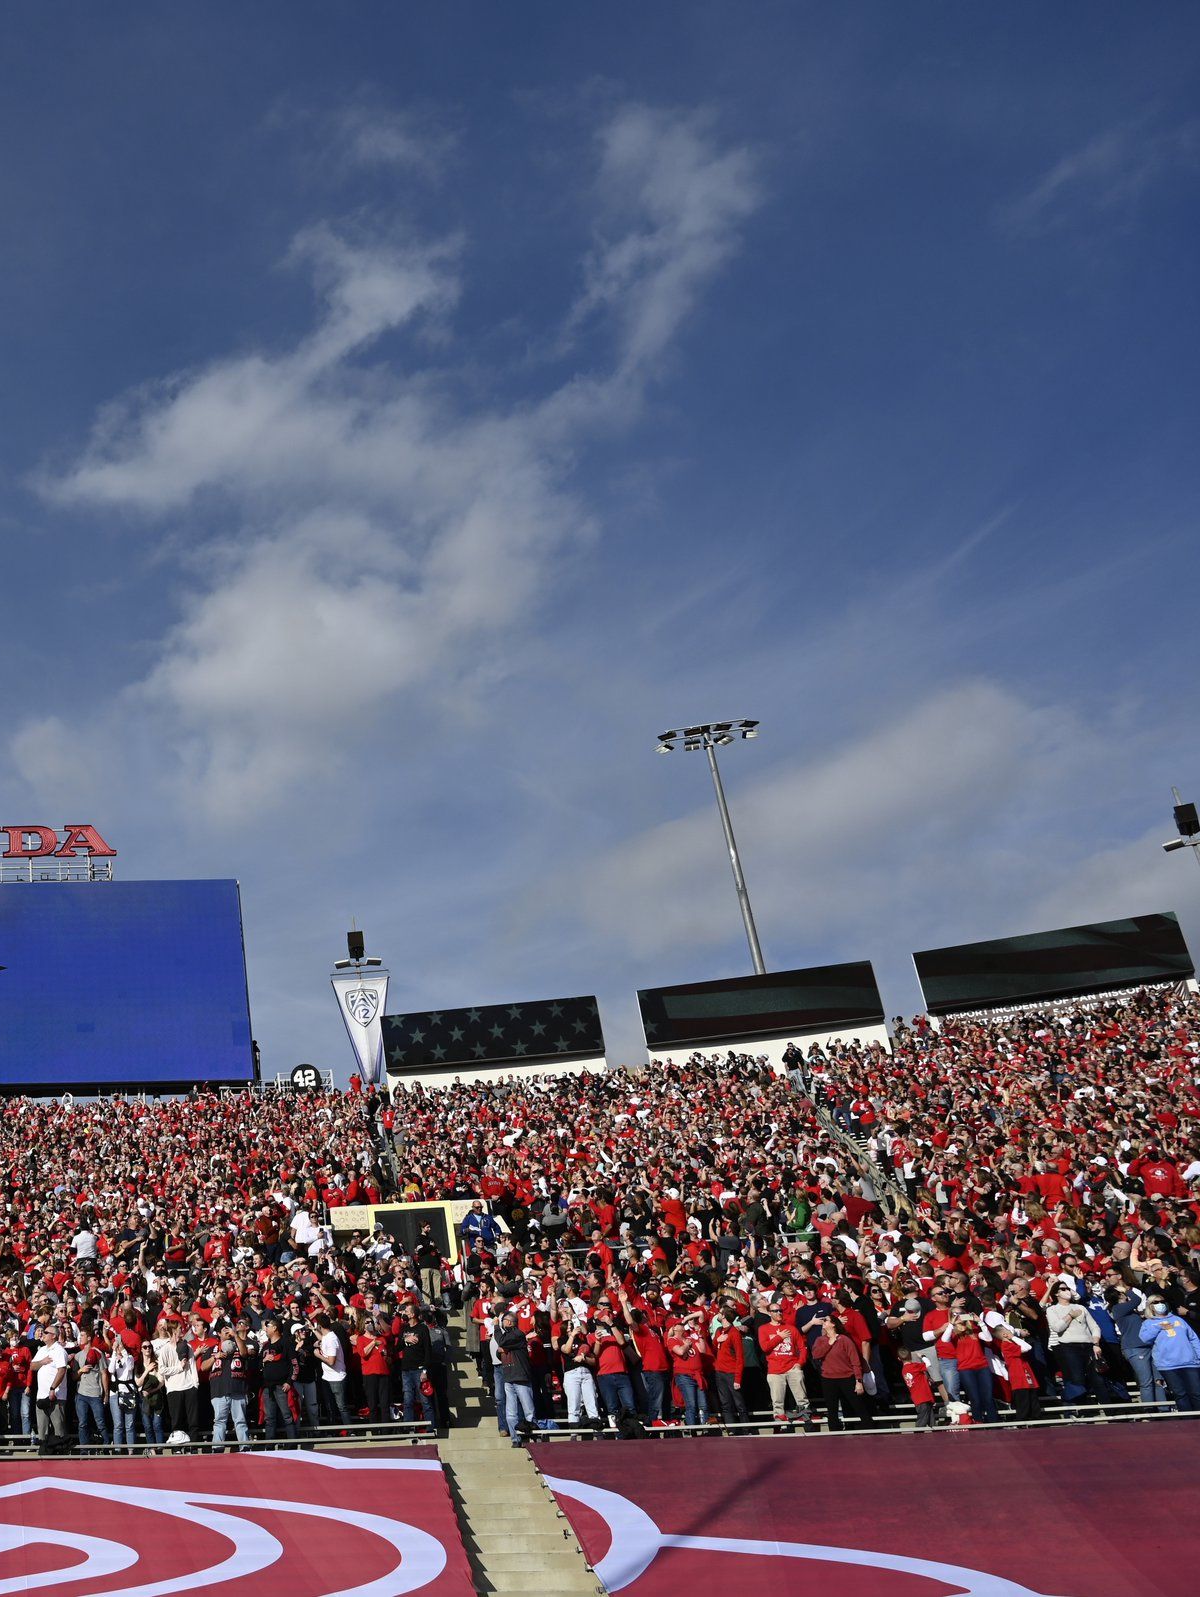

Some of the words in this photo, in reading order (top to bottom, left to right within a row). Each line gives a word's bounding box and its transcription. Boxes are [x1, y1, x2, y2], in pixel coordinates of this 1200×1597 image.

[991, 1000, 1051, 1015] INCIDENTS
[1053, 997, 1069, 1006] OF
[1072, 993, 1097, 1002] FAN
[357, 1008, 371, 1020] 12
[293, 1069, 316, 1088] 42
